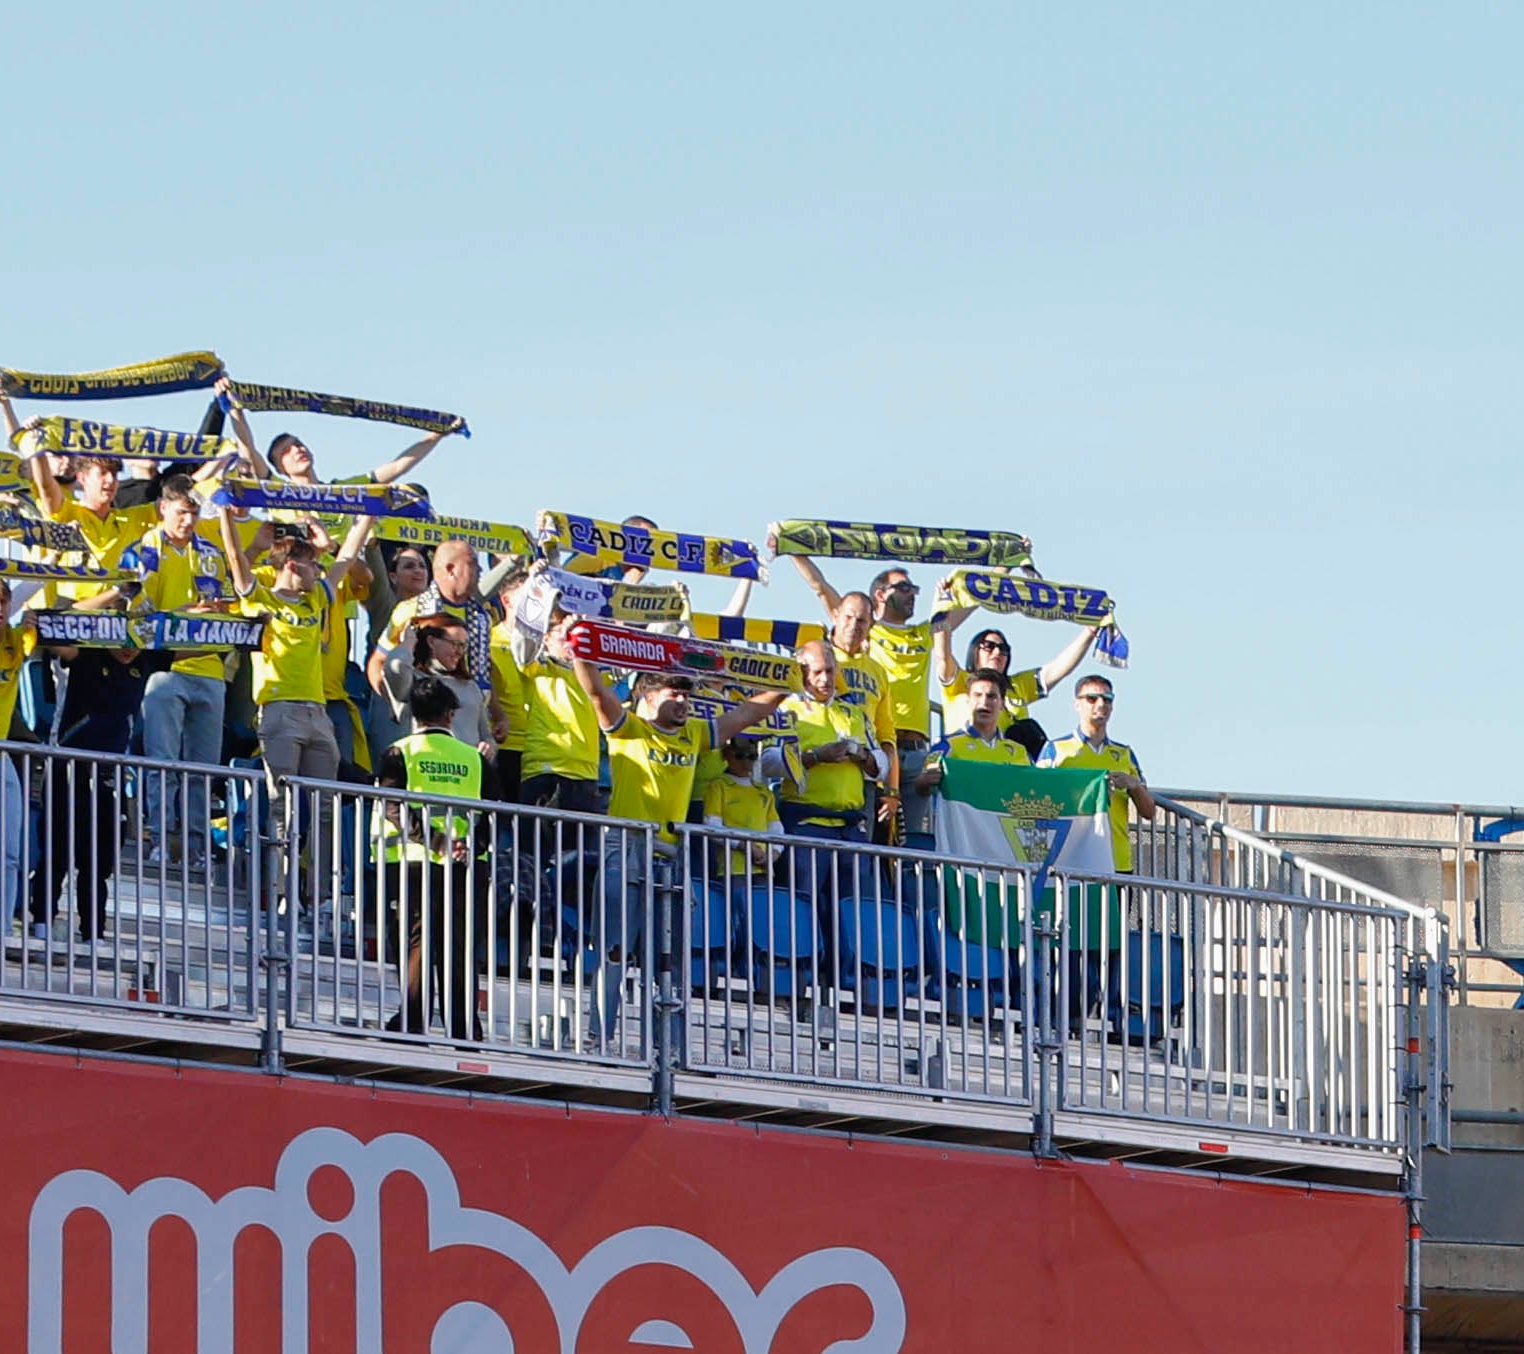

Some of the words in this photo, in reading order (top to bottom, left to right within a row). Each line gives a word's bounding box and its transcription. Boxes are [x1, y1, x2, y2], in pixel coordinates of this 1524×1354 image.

[426, 529, 445, 542] SE
[570, 522, 659, 560] CADIZ
[662, 538, 706, 567] C.F.
[965, 574, 1109, 614] CADIZ
[419, 759, 469, 778] SEGURIDAD
